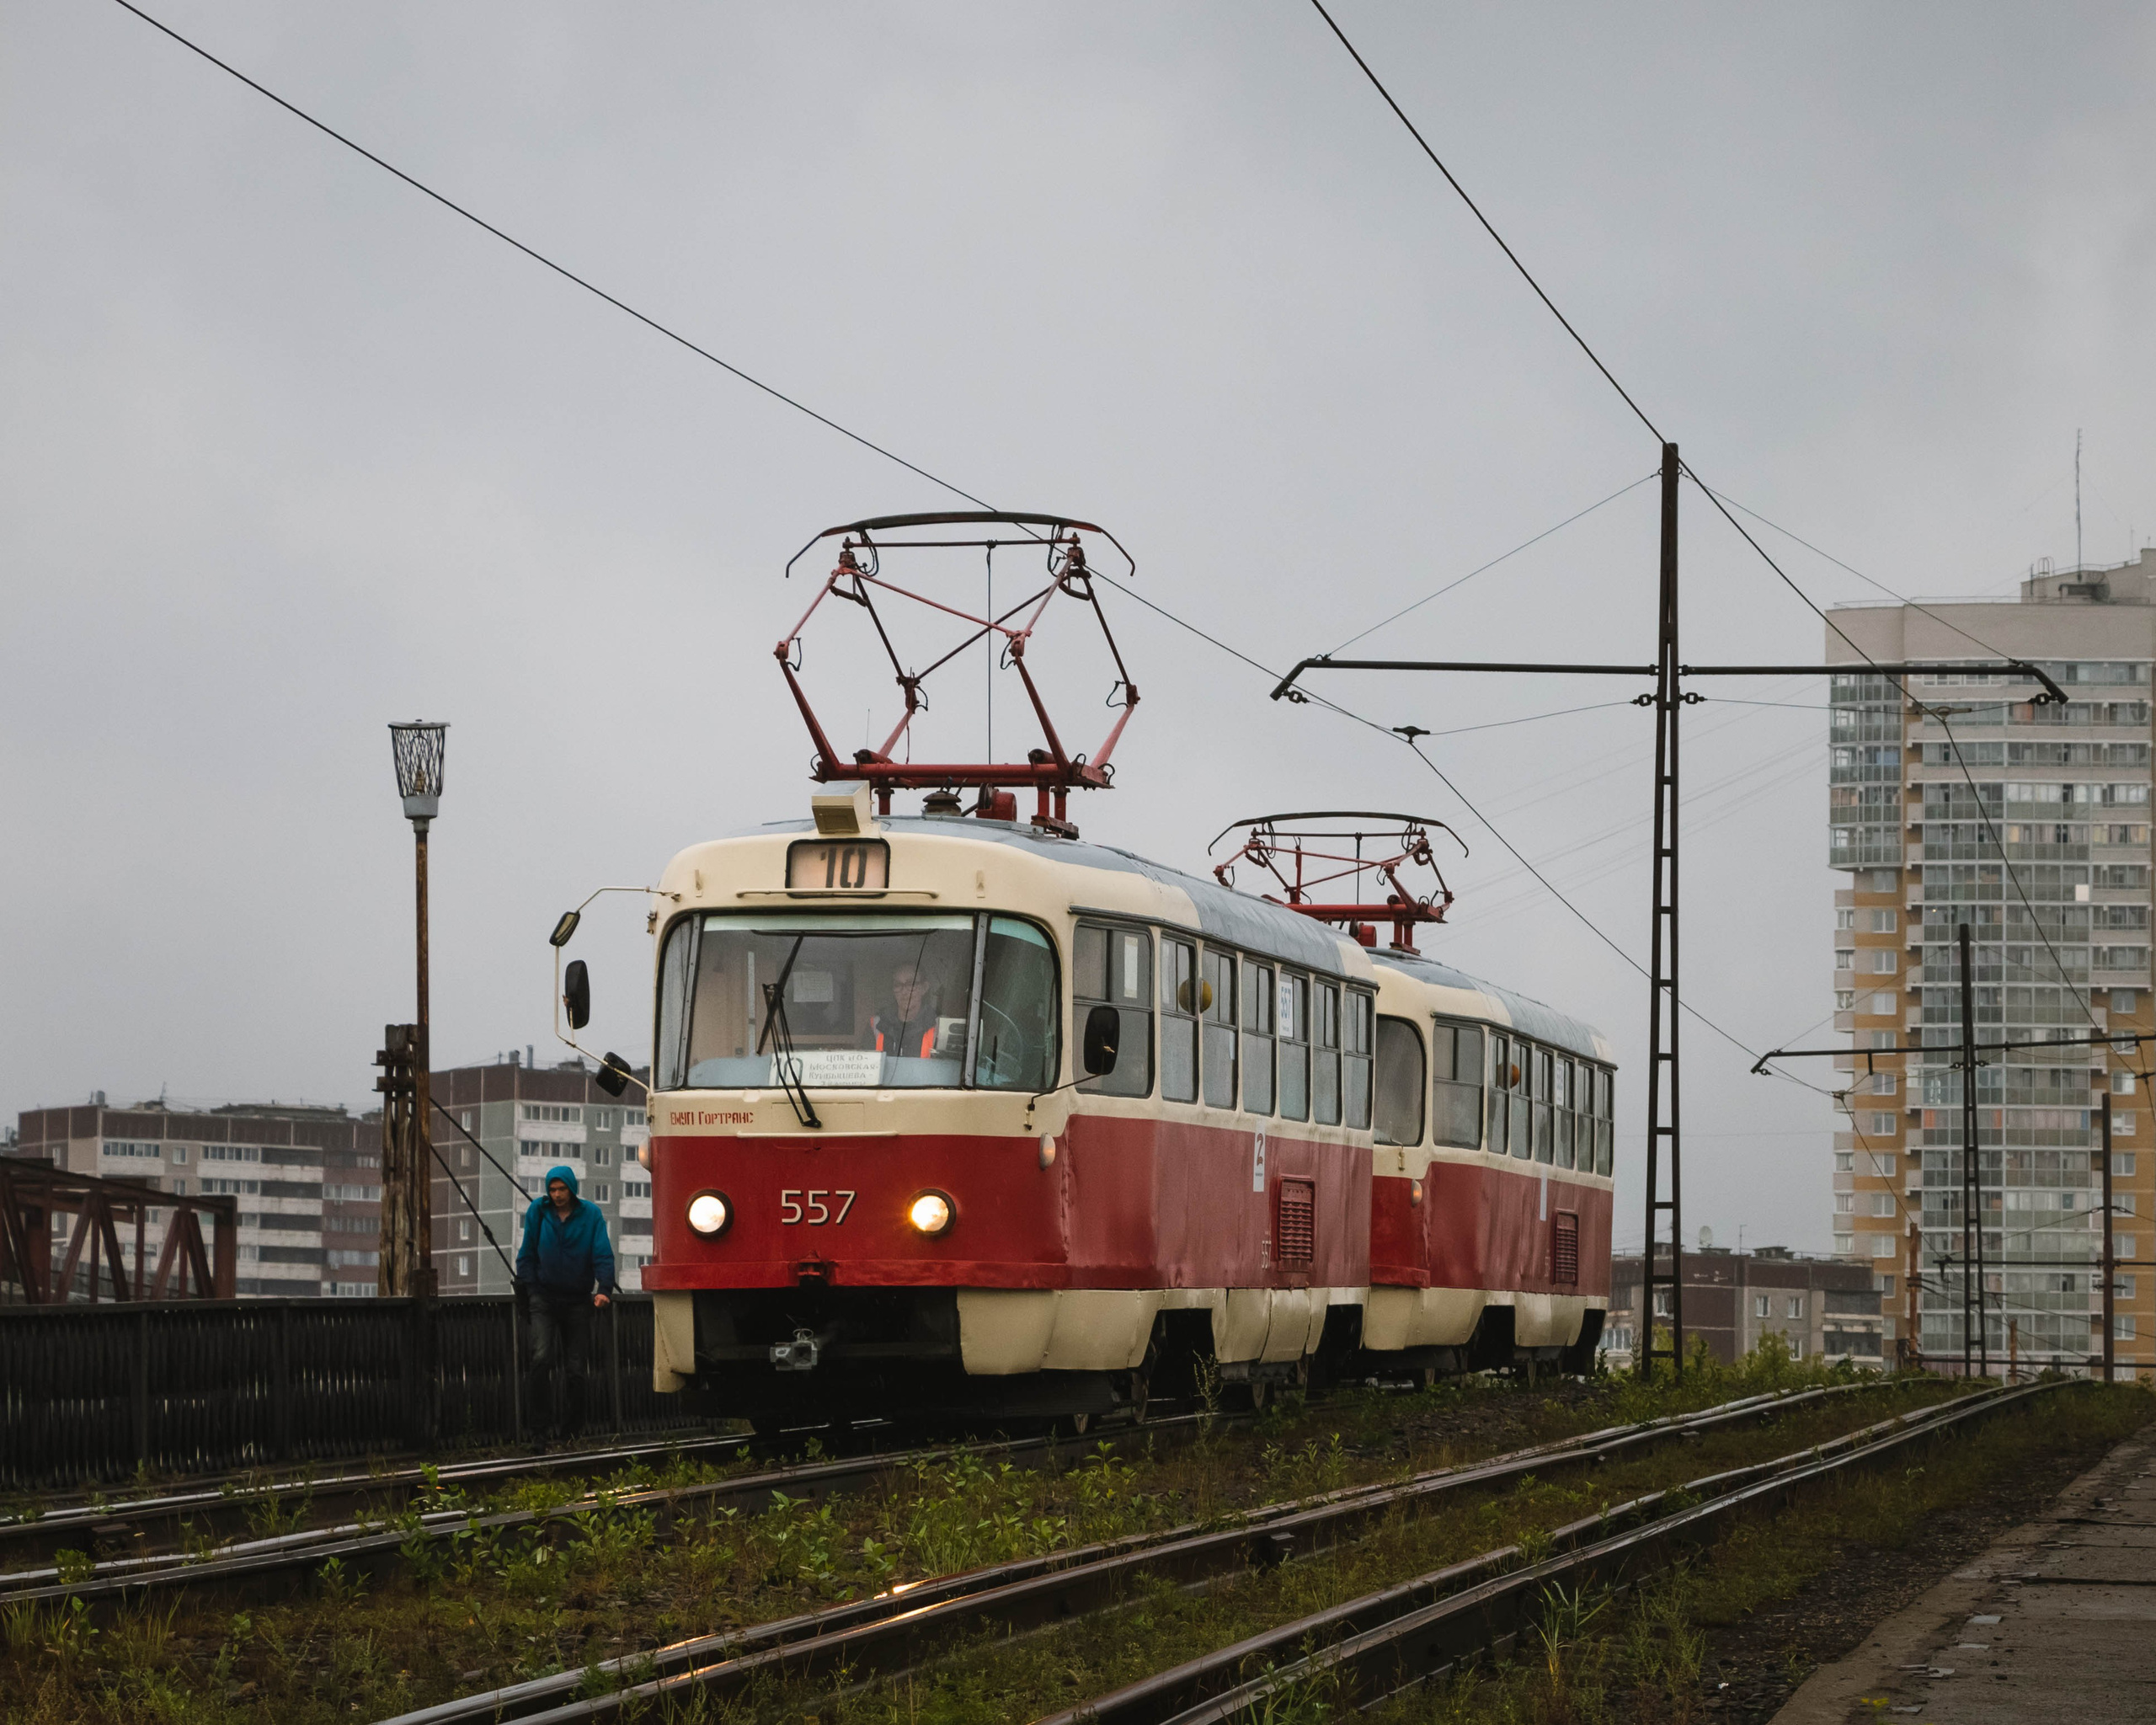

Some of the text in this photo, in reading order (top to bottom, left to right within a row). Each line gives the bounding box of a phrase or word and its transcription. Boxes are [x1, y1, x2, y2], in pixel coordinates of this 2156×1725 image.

[820, 846, 867, 889] 10
[1280, 986, 1291, 1018] 557
[1257, 1133, 1263, 1166] 2
[782, 1189, 857, 1226] 557
